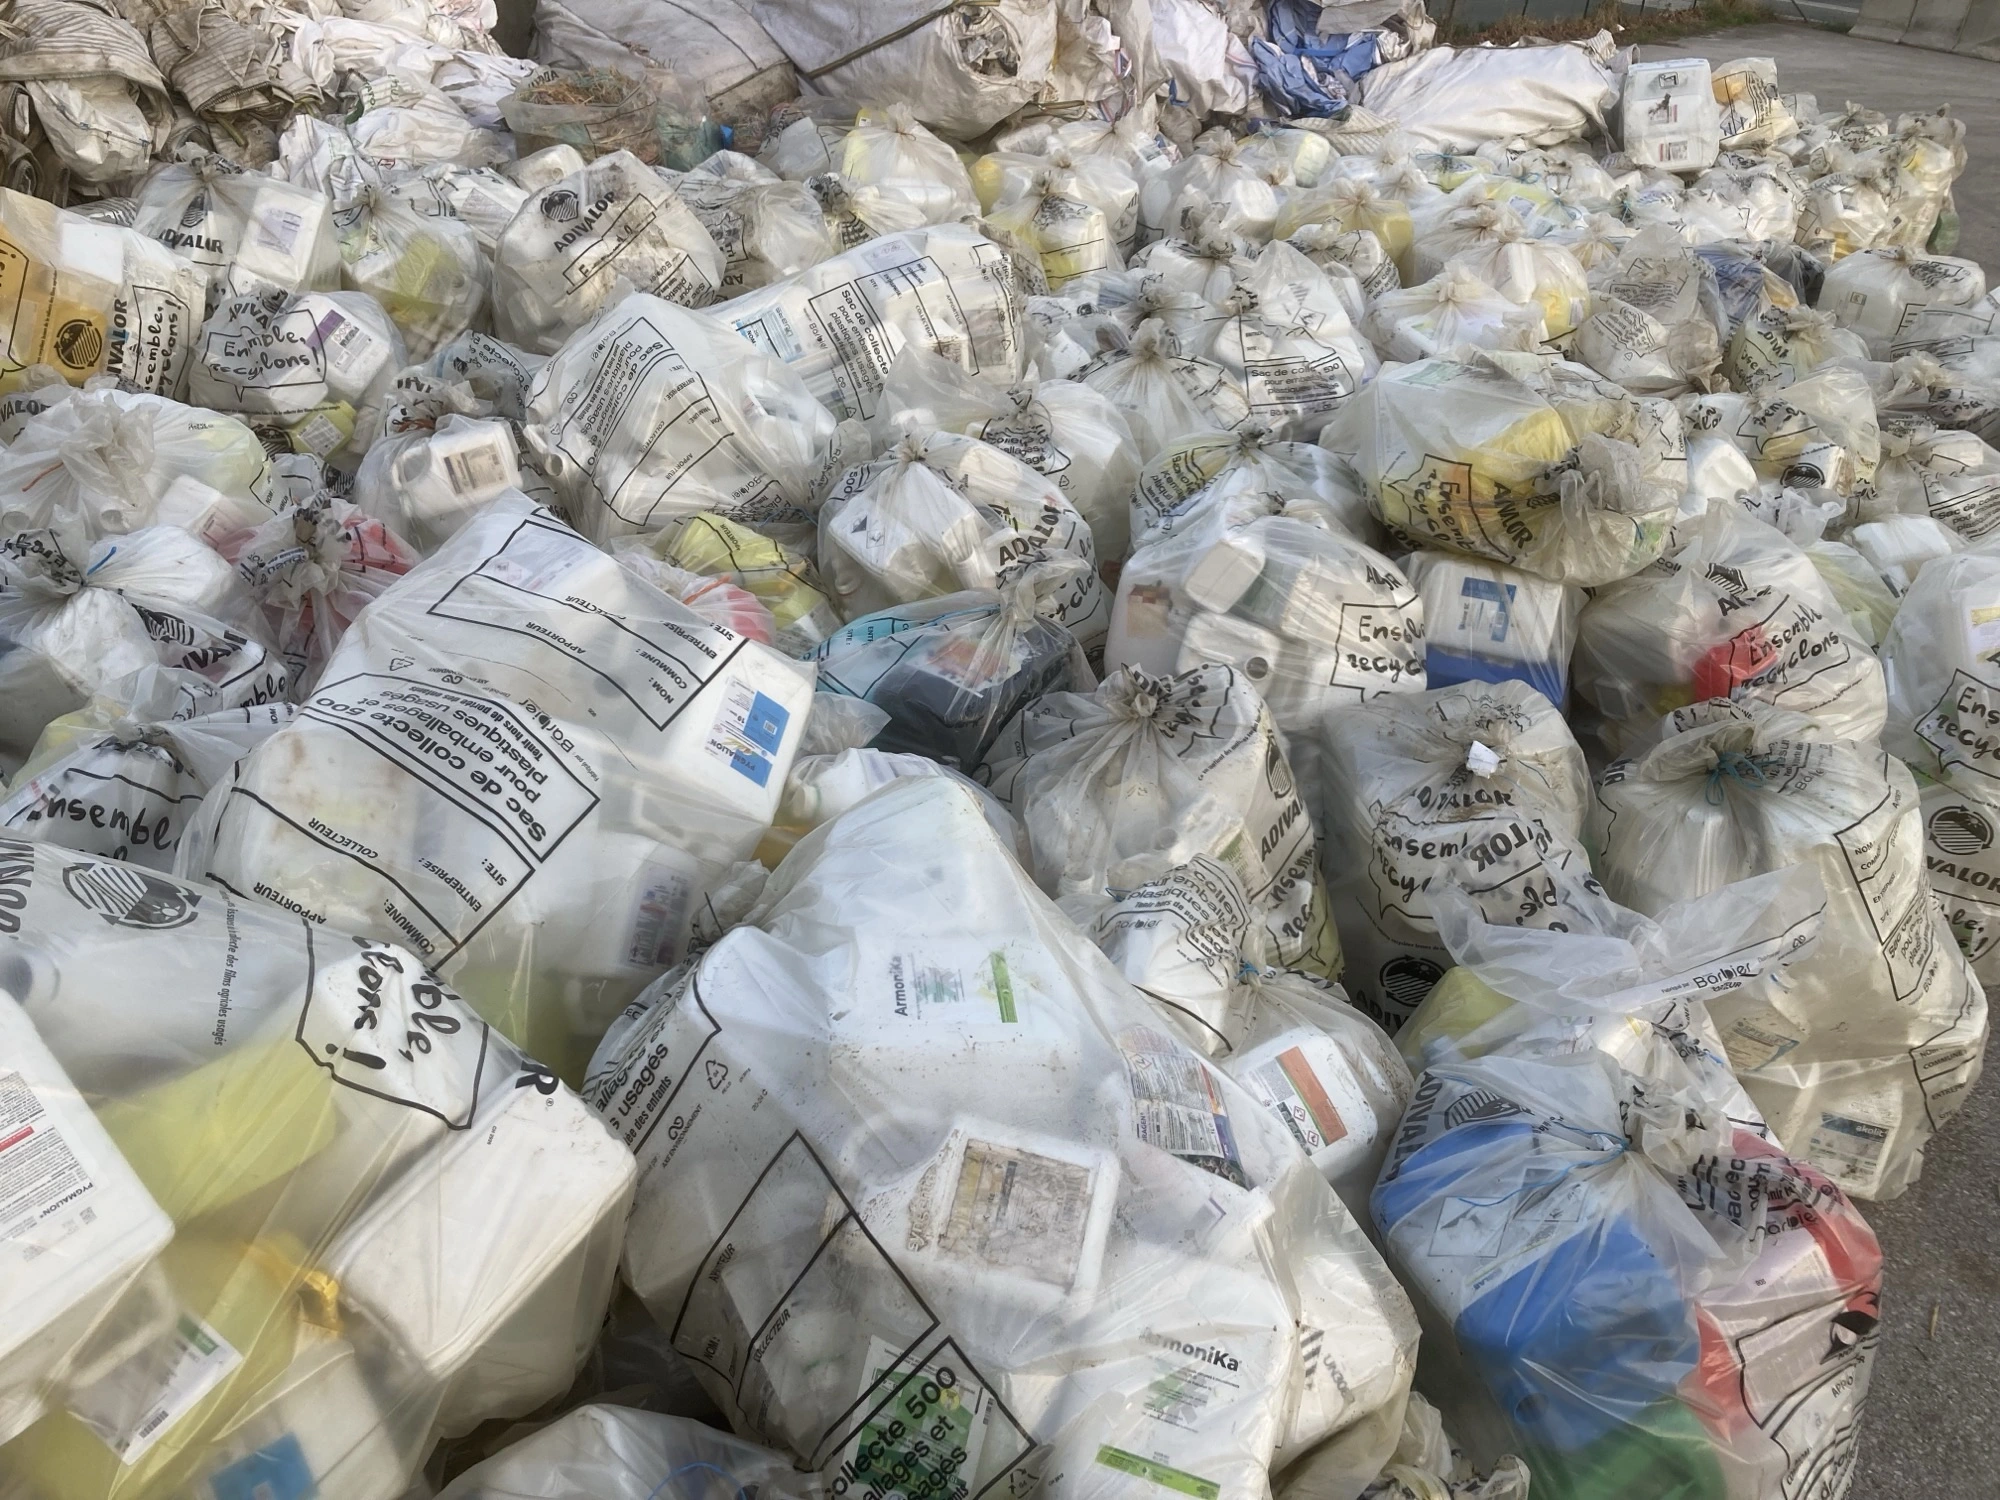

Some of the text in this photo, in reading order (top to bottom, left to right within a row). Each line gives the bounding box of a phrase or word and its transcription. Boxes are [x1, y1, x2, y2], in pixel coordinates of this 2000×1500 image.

[840, 289, 857, 311] Sac
[525, 621, 587, 655] APPORTEUR
[490, 709, 505, 721] de
[503, 719, 521, 740] hors
[518, 697, 576, 754] Barbier
[357, 696, 542, 804] pour emballages et
[379, 689, 549, 787] plastiques usagés
[519, 736, 544, 764] Tenir
[315, 696, 547, 843] Sac de collecte 500
[308, 816, 379, 860] COLLECTEUR
[253, 881, 327, 926] APPORTEUR
[1692, 962, 1751, 990] Barbier
[617, 1041, 669, 1117] usagés
[633, 1075, 673, 1132] des enfants
[904, 1366, 957, 1420] 500
[929, 1413, 956, 1442] et
